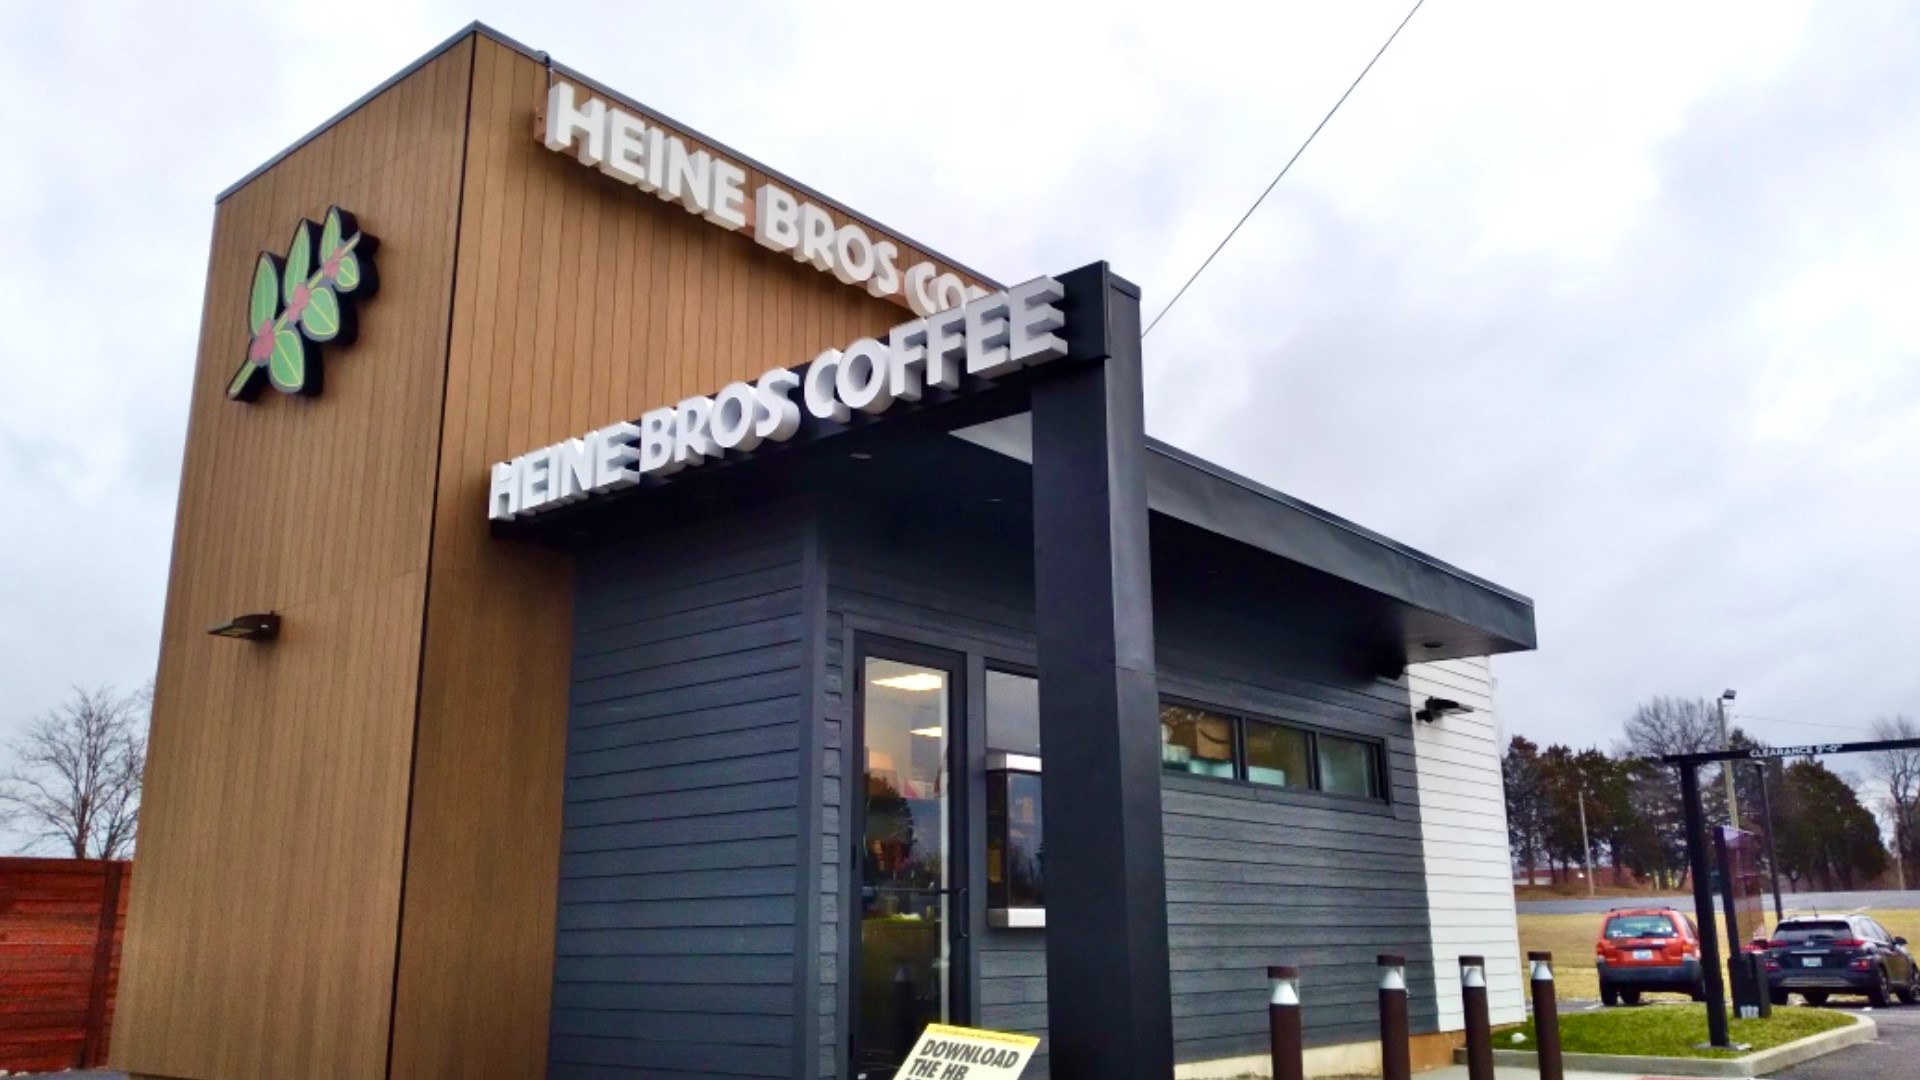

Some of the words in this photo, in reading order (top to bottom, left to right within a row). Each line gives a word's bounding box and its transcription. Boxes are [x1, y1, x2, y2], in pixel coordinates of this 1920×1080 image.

[546, 82, 746, 230] HEINE
[755, 183, 898, 297] BROS
[905, 261, 990, 317] CO
[489, 421, 640, 522] HEINE
[640, 367, 800, 476] BROS
[805, 275, 1068, 423] COFFEE
[1749, 746, 1813, 757] CLEARANCE
[920, 1039, 1020, 1068] DOWNLOAD
[908, 1058, 942, 1078] THE
[939, 1062, 969, 1080] HB
